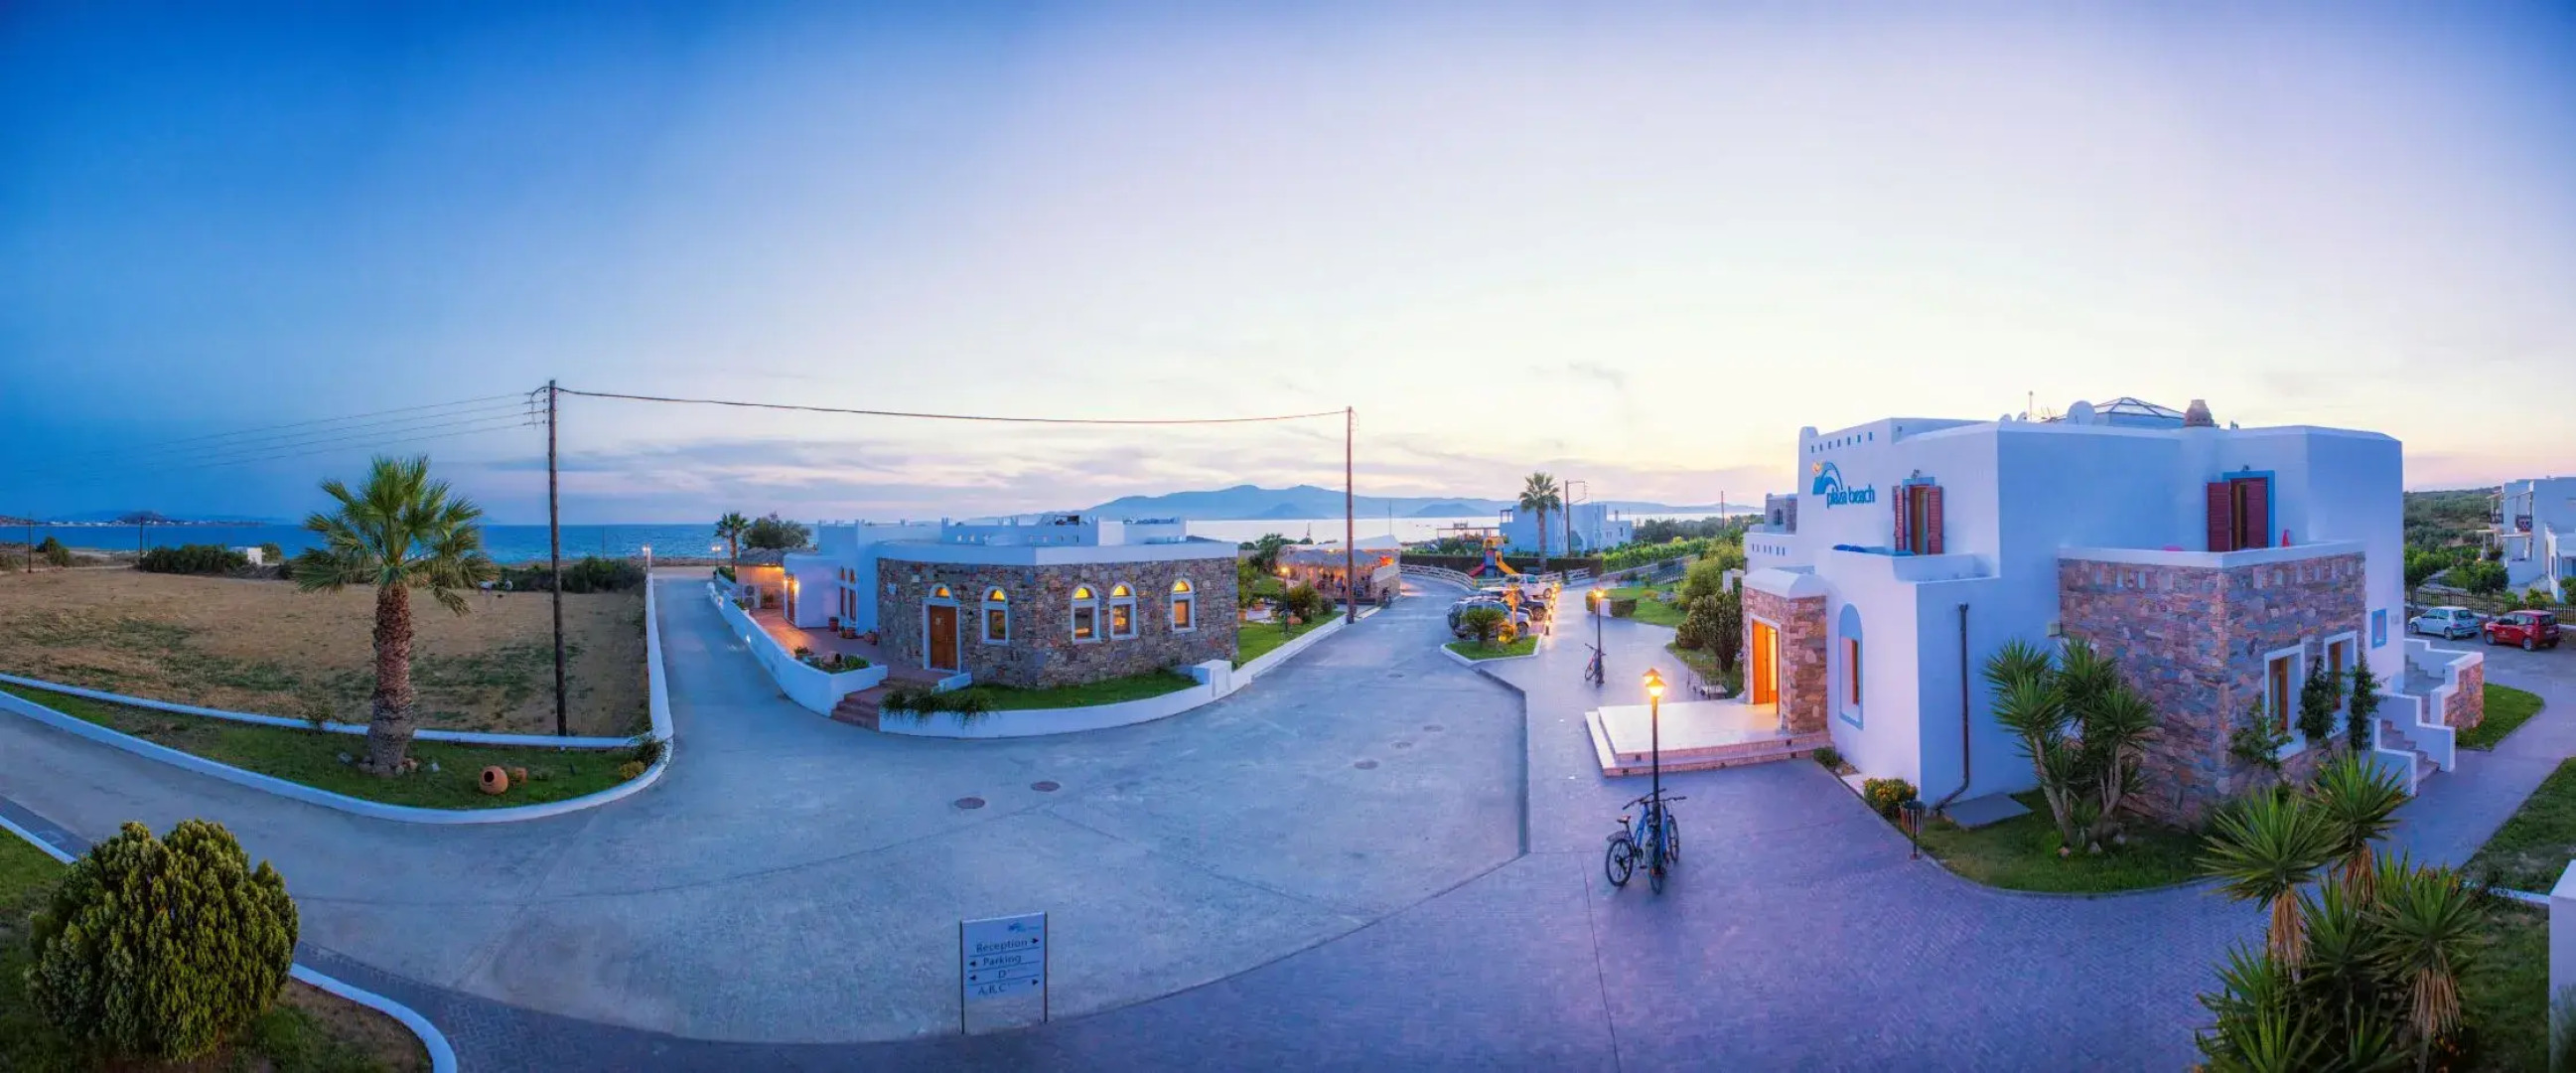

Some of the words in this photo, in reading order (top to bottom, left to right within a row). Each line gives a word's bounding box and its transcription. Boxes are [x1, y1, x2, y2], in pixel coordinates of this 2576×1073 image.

[1848, 484, 1875, 504] beach
[976, 938, 1028, 953] Reception
[983, 955, 1022, 966] Parking
